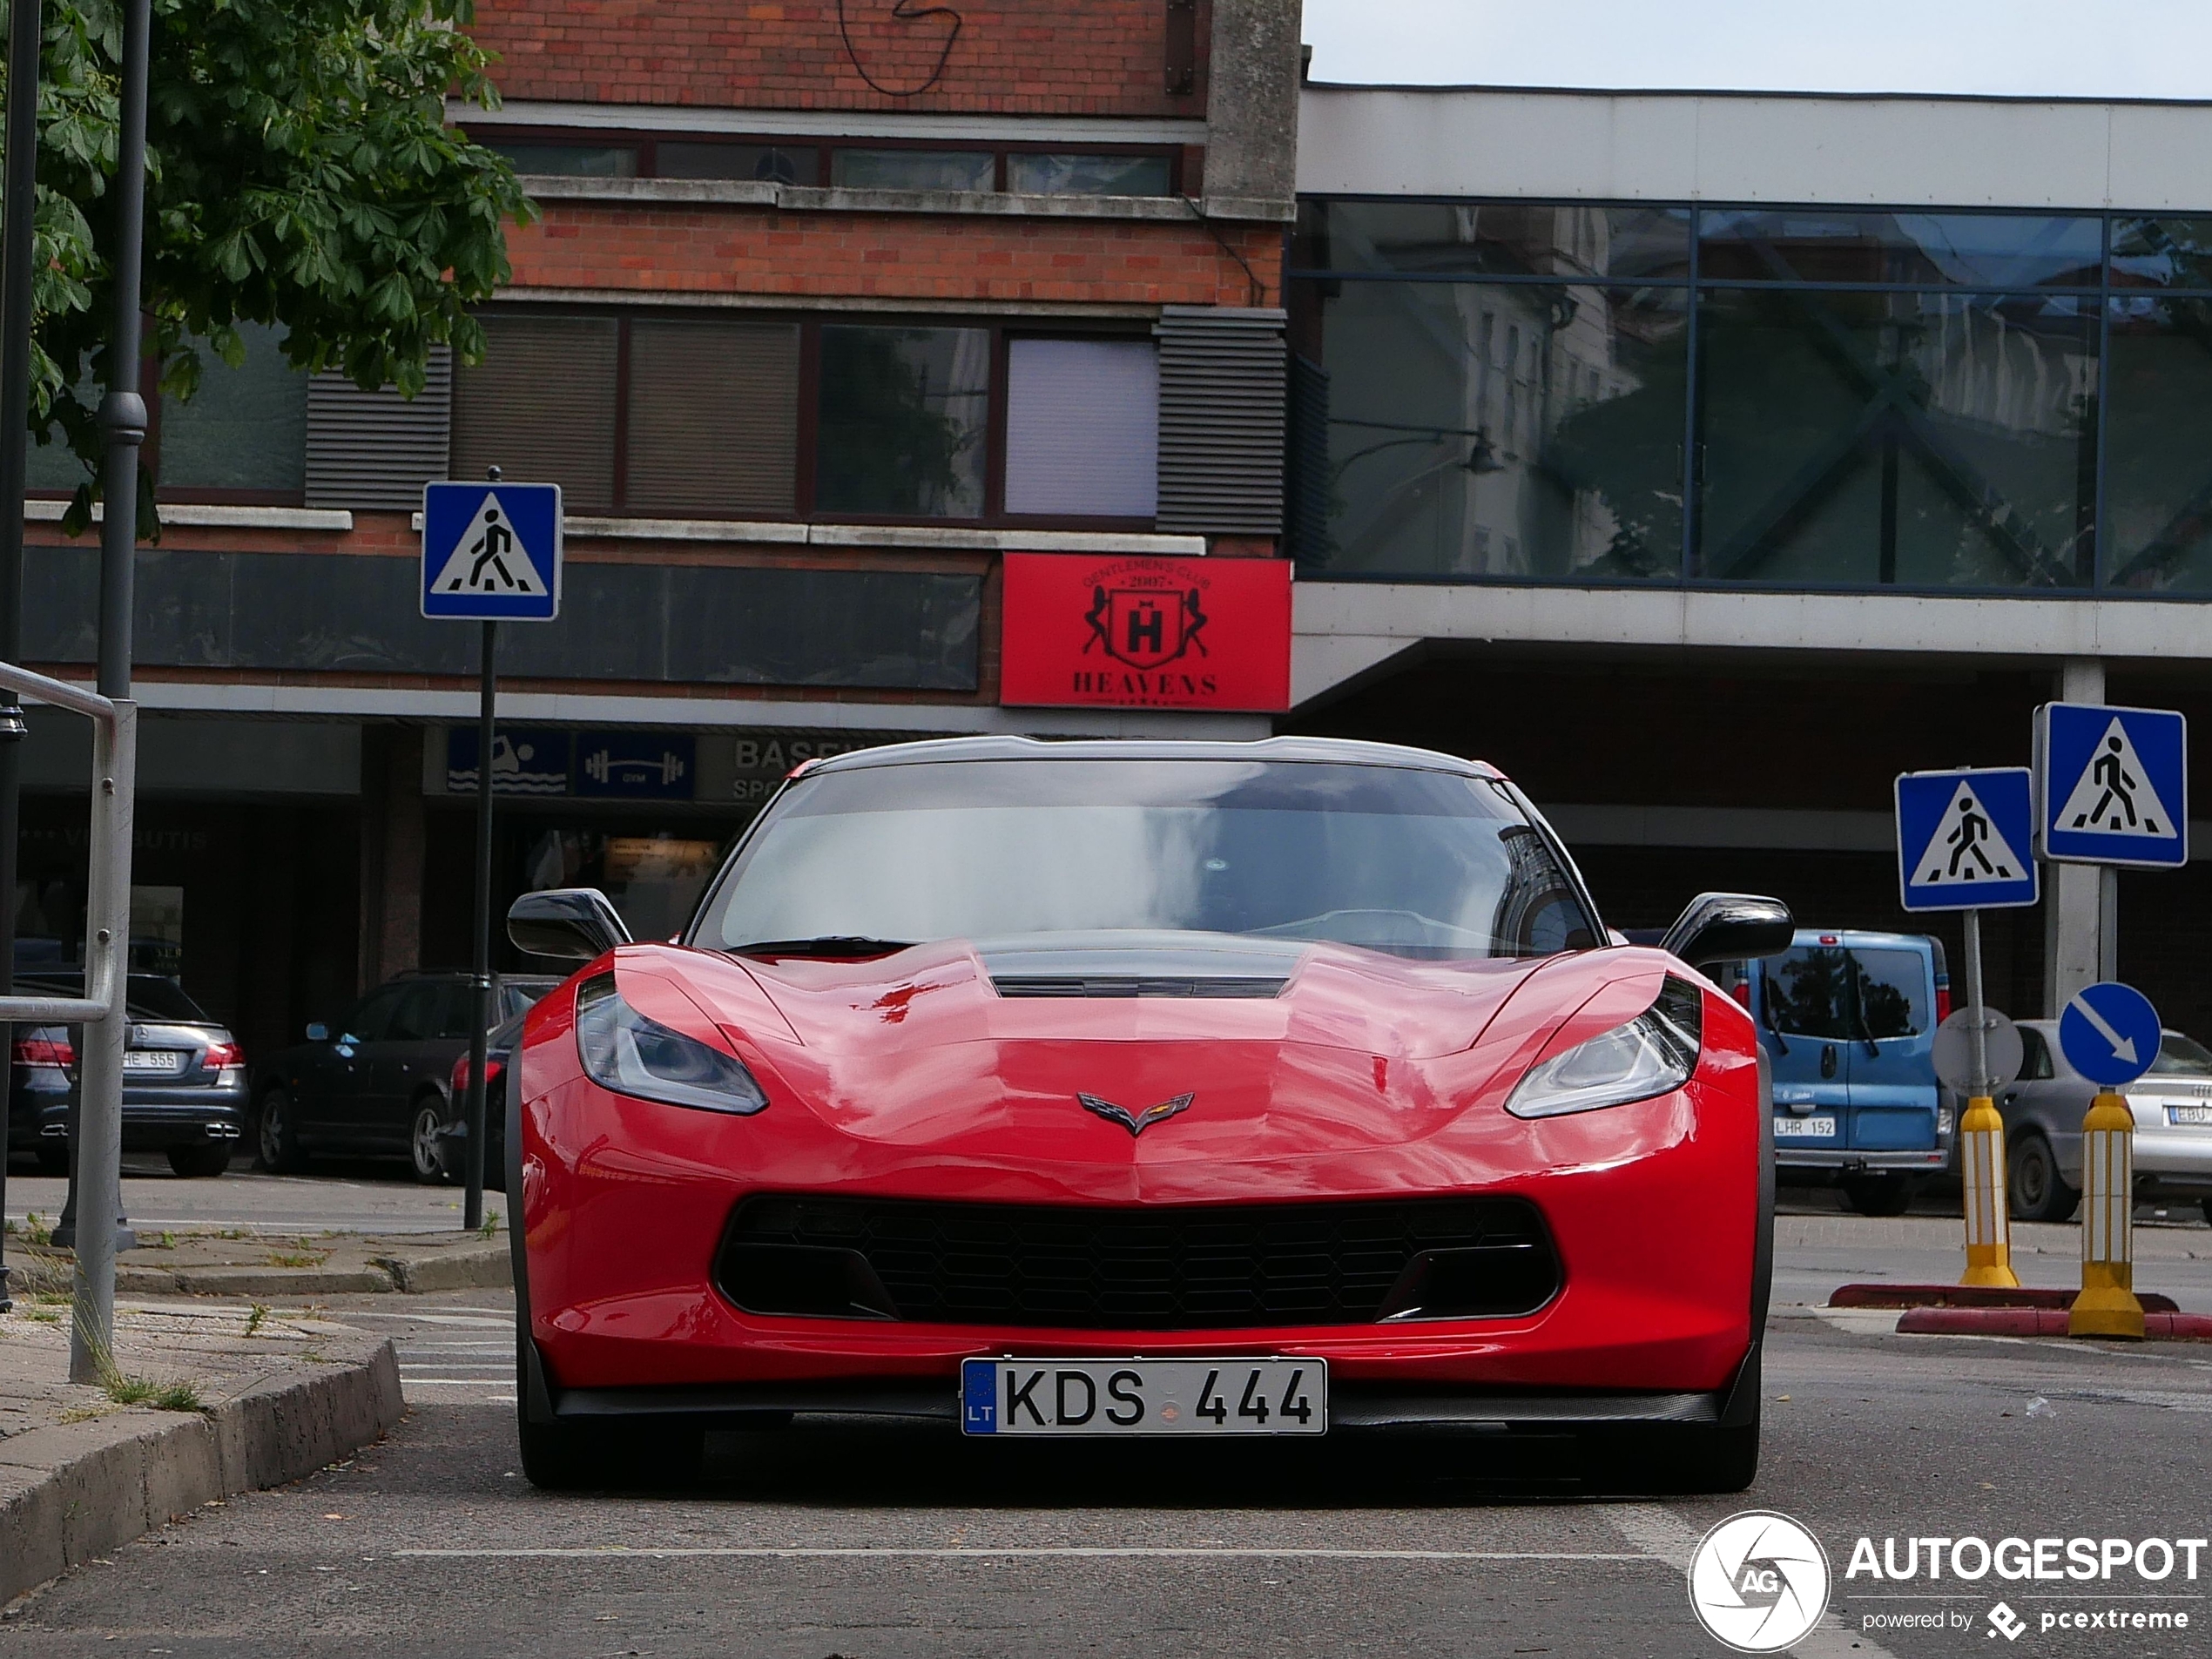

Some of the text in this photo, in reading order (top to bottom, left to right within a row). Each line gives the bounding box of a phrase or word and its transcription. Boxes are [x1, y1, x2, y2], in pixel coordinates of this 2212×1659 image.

[1128, 610, 1163, 652] H
[1074, 671, 1217, 695] HEAVENS
[736, 739, 866, 770] BASE
[64, 828, 207, 850] VIBUTIS
[123, 1053, 174, 1066] HE 555
[1776, 1121, 1832, 1134] LHR 152
[1006, 1369, 1312, 1426] KDS 444
[968, 1406, 993, 1421] LT
